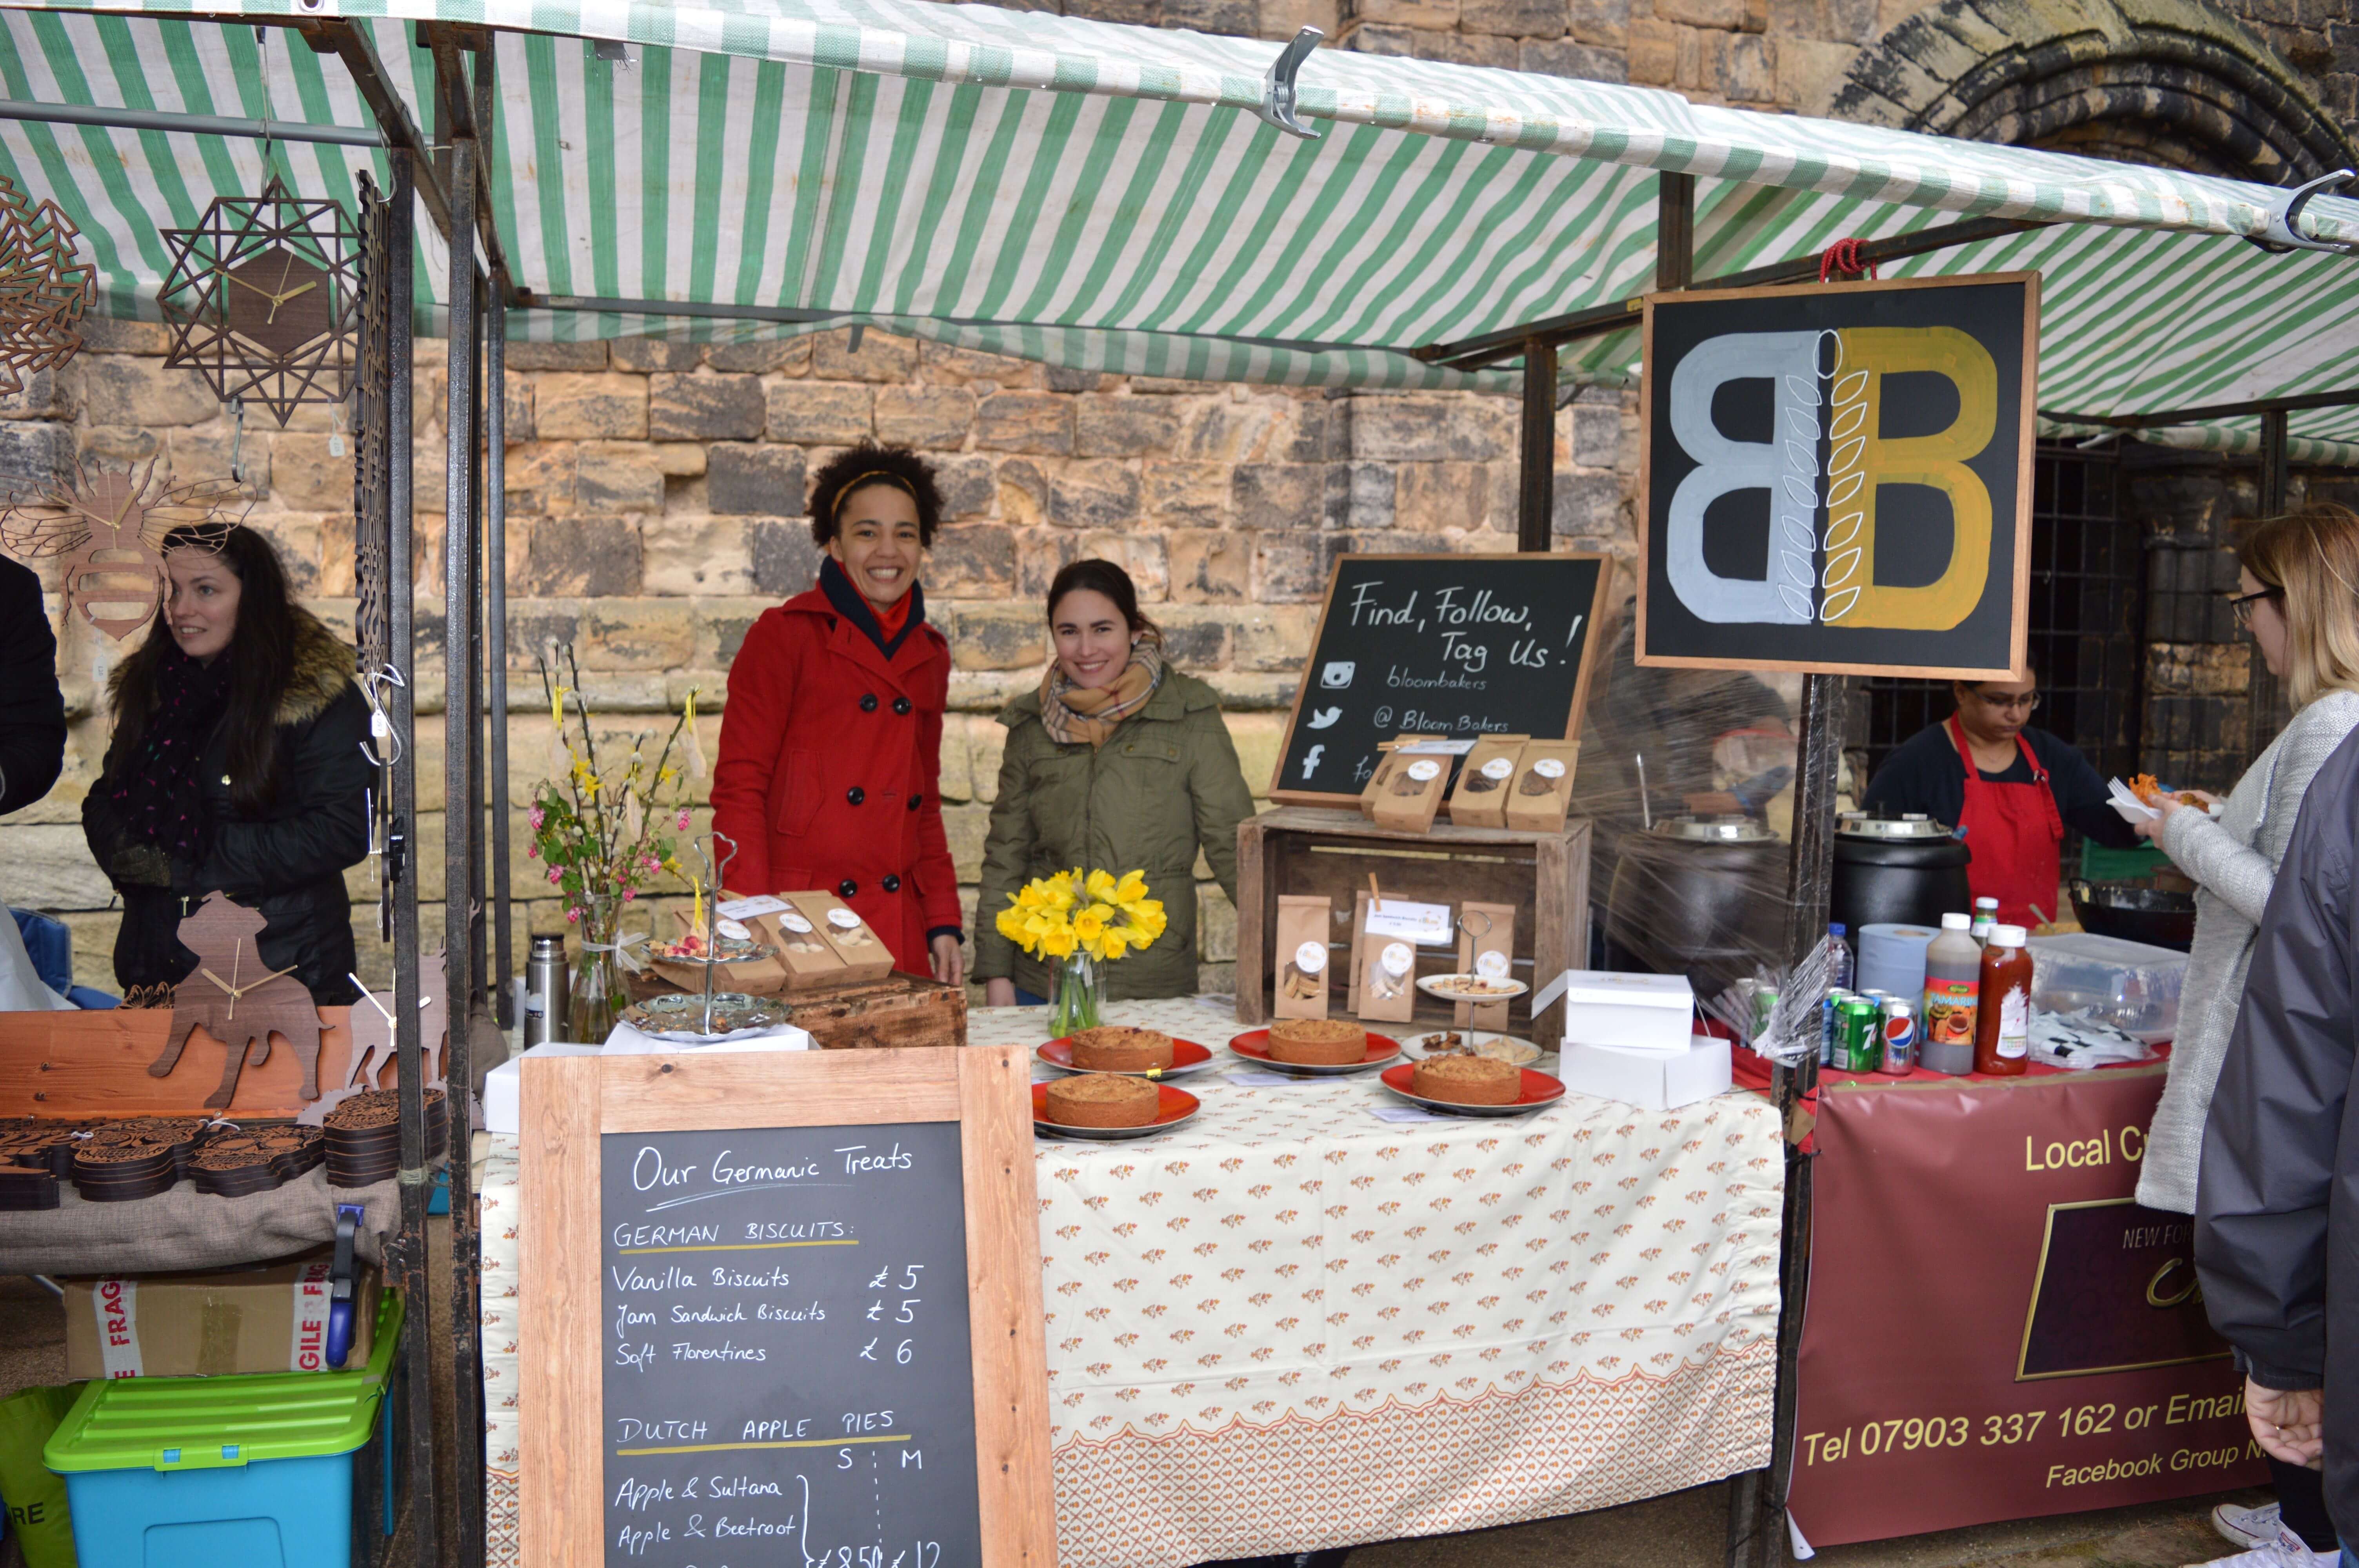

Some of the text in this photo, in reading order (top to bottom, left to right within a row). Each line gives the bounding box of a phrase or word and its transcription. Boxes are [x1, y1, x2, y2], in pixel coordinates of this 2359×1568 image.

[1351, 581, 1532, 632] Find, Follow,
[1441, 632, 1489, 672] Tag
[1387, 664, 1486, 690] bloombakers
[1399, 710, 1453, 731] Bloom
[1458, 715, 1509, 732] Bakers
[1354, 755, 1372, 783] fa
[633, 1143, 912, 1191] Our Germanic Treats
[2026, 1129, 2110, 1171] Local
[614, 1221, 855, 1247] GERMAN BISCUITS:
[2123, 1223, 2194, 1249] NEW FOR
[612, 1266, 697, 1291] Vanilla
[712, 1267, 790, 1287] Biscuits
[899, 1265, 924, 1290] 5
[100, 1279, 130, 1347] FRAG
[616, 1304, 656, 1338] Jam
[671, 1304, 747, 1324] Sandwich
[757, 1300, 826, 1321] Biscuits
[895, 1299, 921, 1323] 5
[616, 1343, 656, 1372] Soft
[672, 1341, 767, 1363] Florentines
[897, 1339, 913, 1364] 6
[616, 1410, 894, 1443] DUTCH APPLE PIES
[1803, 1427, 1851, 1467] Tel
[1860, 1417, 1969, 1457] 07903
[1980, 1411, 2046, 1446] 337
[2057, 1403, 2116, 1437] 162
[2124, 1405, 2158, 1430] or
[837, 1448, 922, 1469] S M
[2045, 1439, 2266, 1488] Facebook Group N
[615, 1476, 783, 1511] Apple & Sultana
[618, 1514, 796, 1555] Apple & Beetroot
